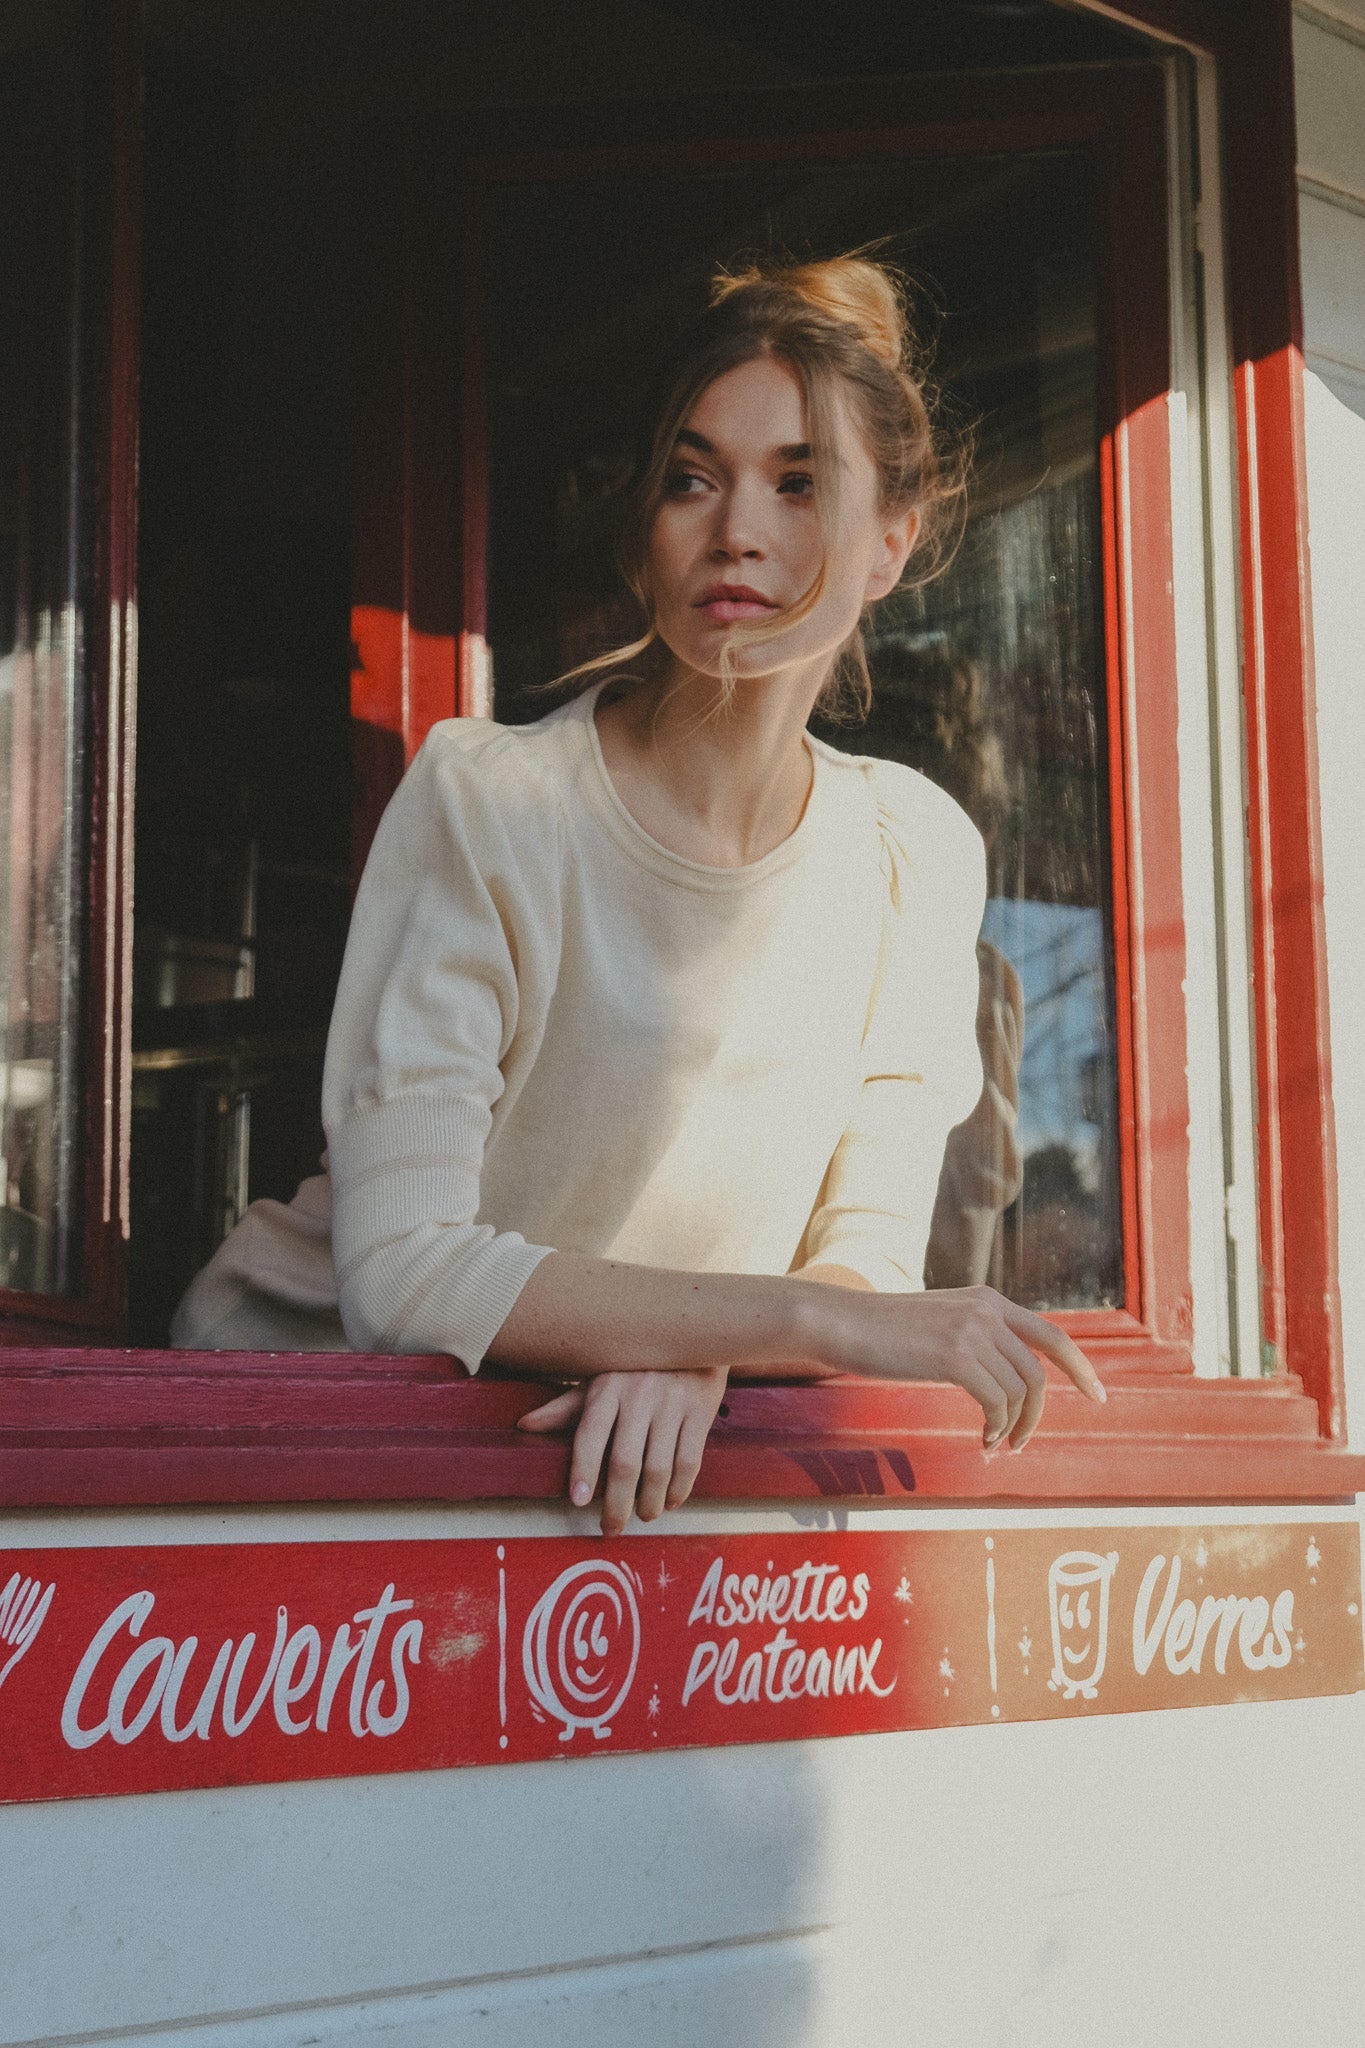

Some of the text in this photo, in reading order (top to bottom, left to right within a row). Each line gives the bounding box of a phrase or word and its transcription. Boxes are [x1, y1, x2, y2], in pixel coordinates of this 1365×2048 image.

[688, 1557, 871, 1627] Assiettes
[1132, 1554, 1295, 1675] Verres
[60, 1583, 423, 1749] Couverts
[681, 1628, 898, 1706] Plateaux
